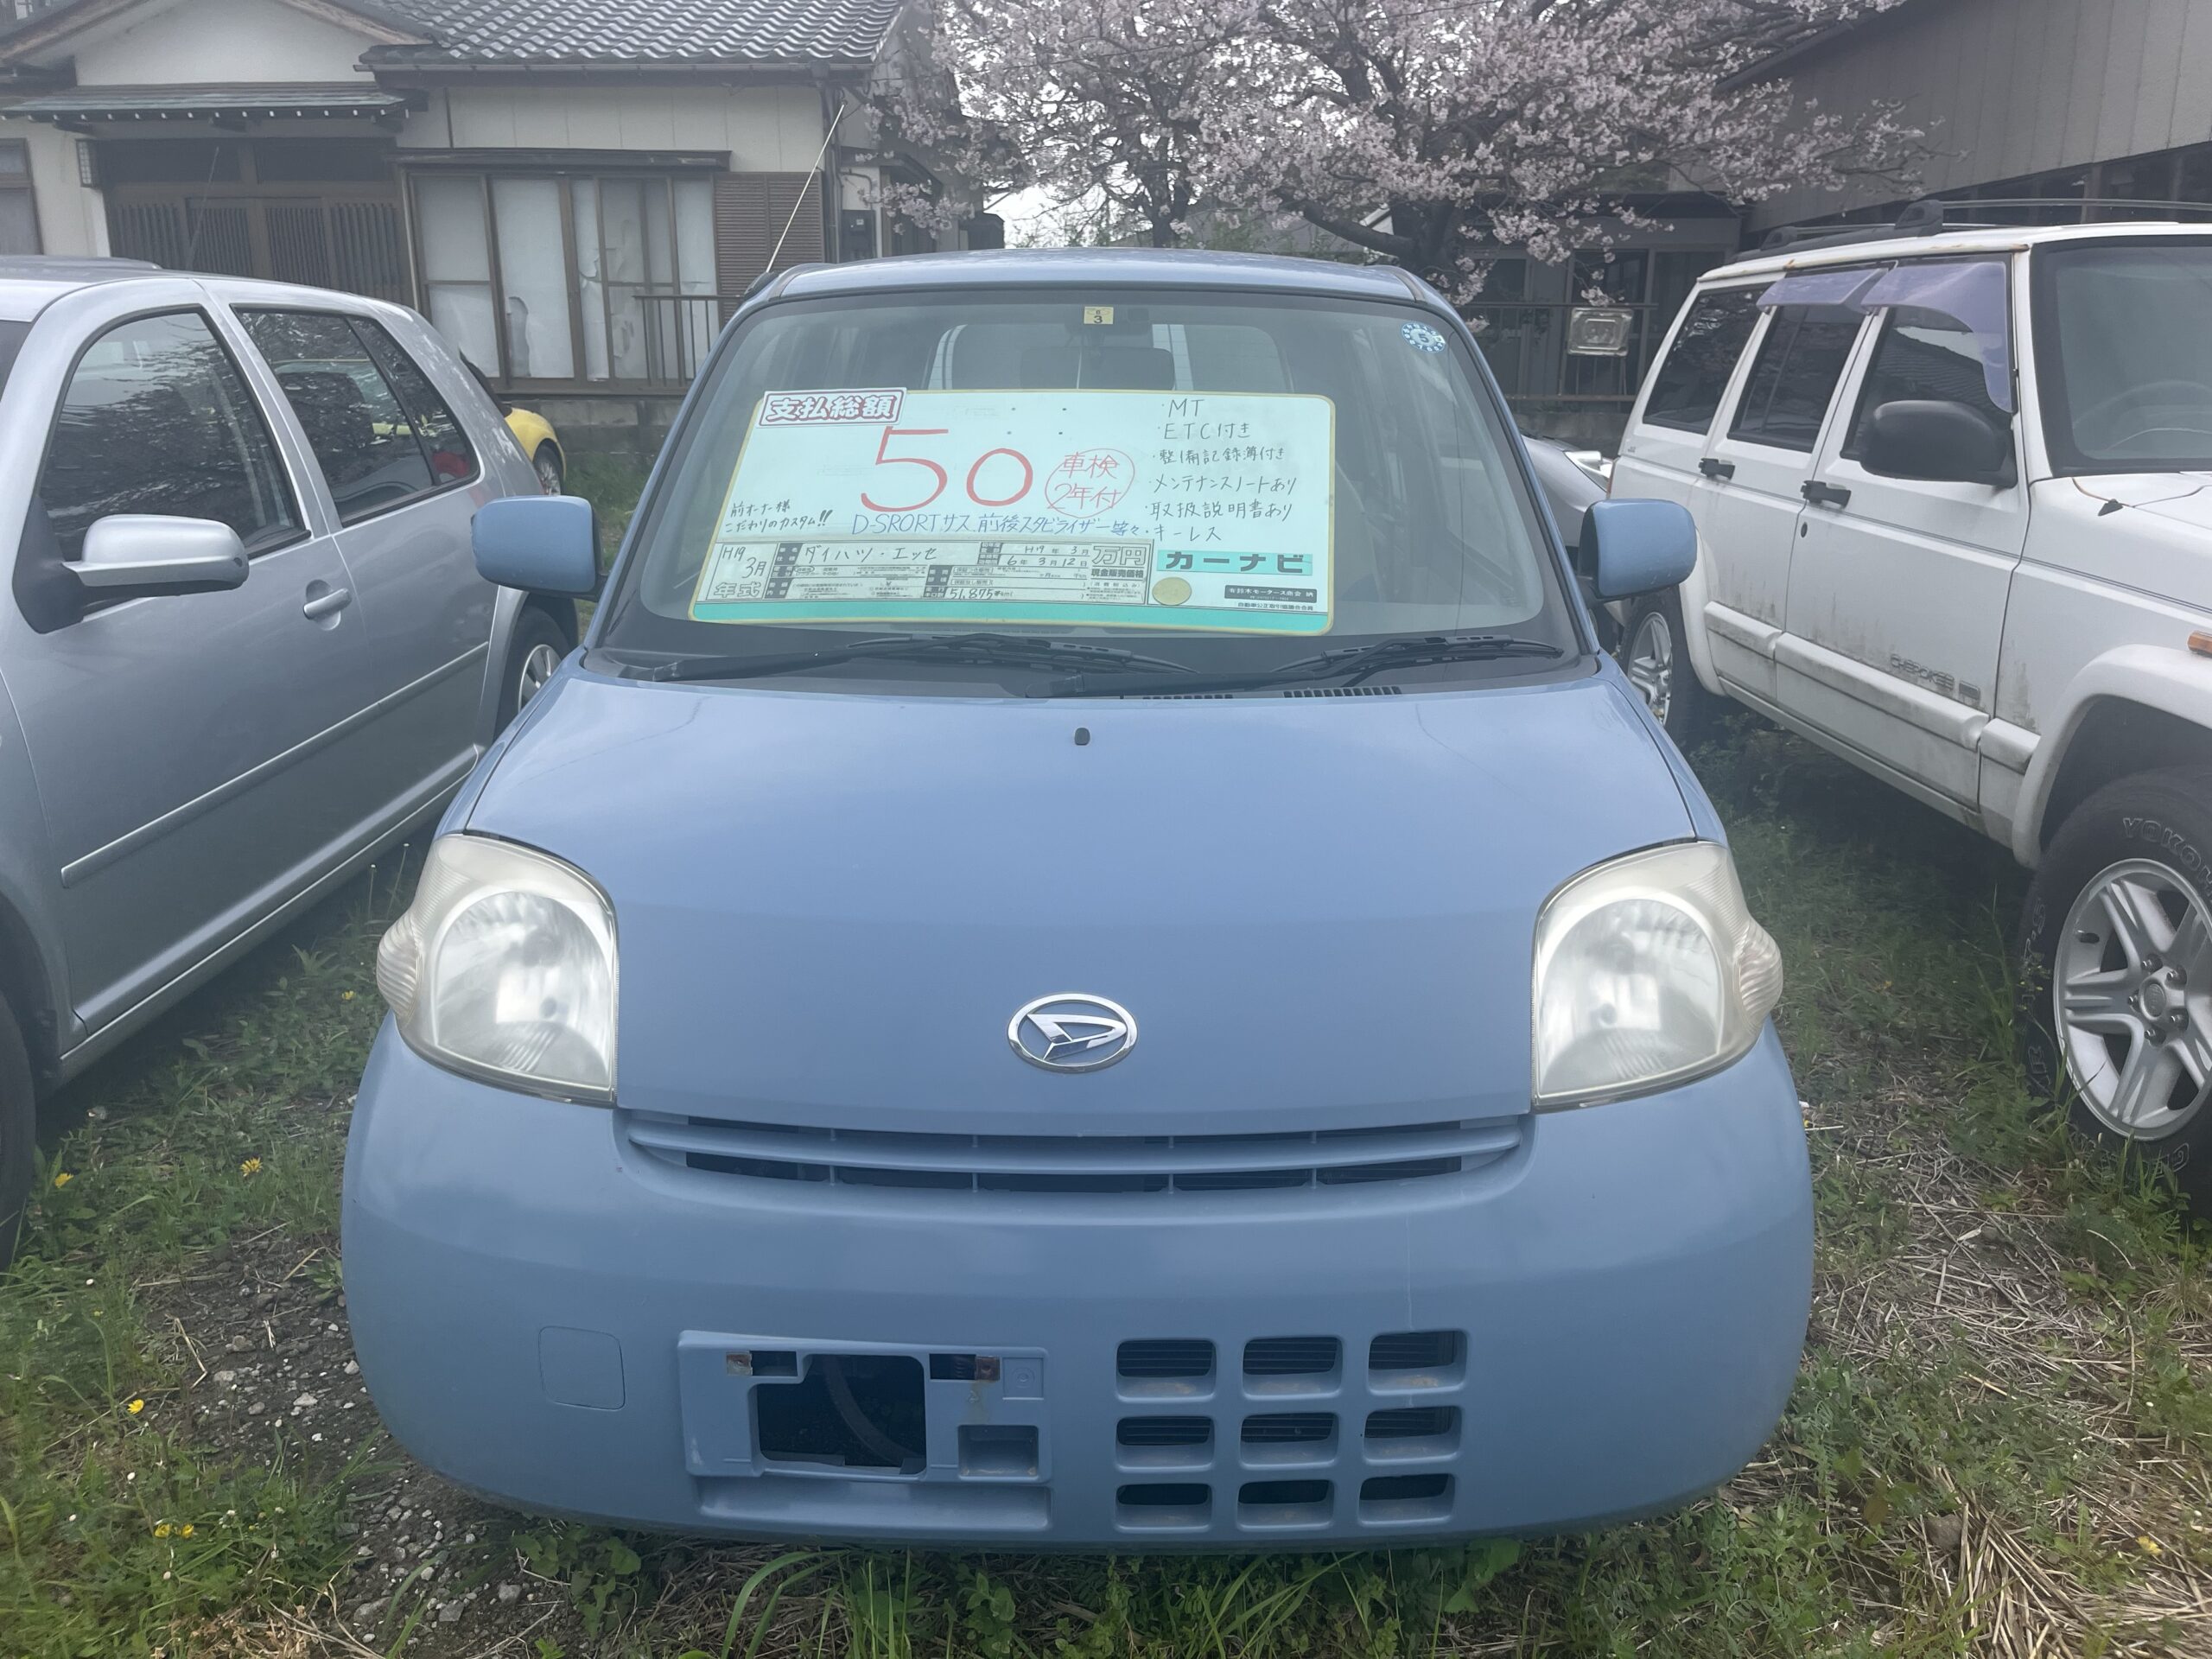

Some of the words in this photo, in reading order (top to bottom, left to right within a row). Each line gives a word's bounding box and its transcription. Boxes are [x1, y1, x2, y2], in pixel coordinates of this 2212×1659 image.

[1418, 334, 1429, 343] 5
[766, 395, 898, 422] 支払総額
[1168, 398, 1205, 417] MT
[861, 426, 1033, 512] 50
[1058, 452, 1120, 480] 車検
[1154, 474, 1297, 495] メンテナンスノートあり
[1046, 483, 1122, 510] 2年付
[730, 499, 791, 518] 前オーナー様
[1151, 499, 1293, 521] 取扱説明書あり
[1154, 524, 1222, 542] キーレス
[722, 547, 747, 562] H19
[1091, 545, 1147, 566] 万円
[1166, 551, 1304, 574] カーナビ
[742, 556, 767, 579] 3月
[714, 582, 762, 598] 年式
